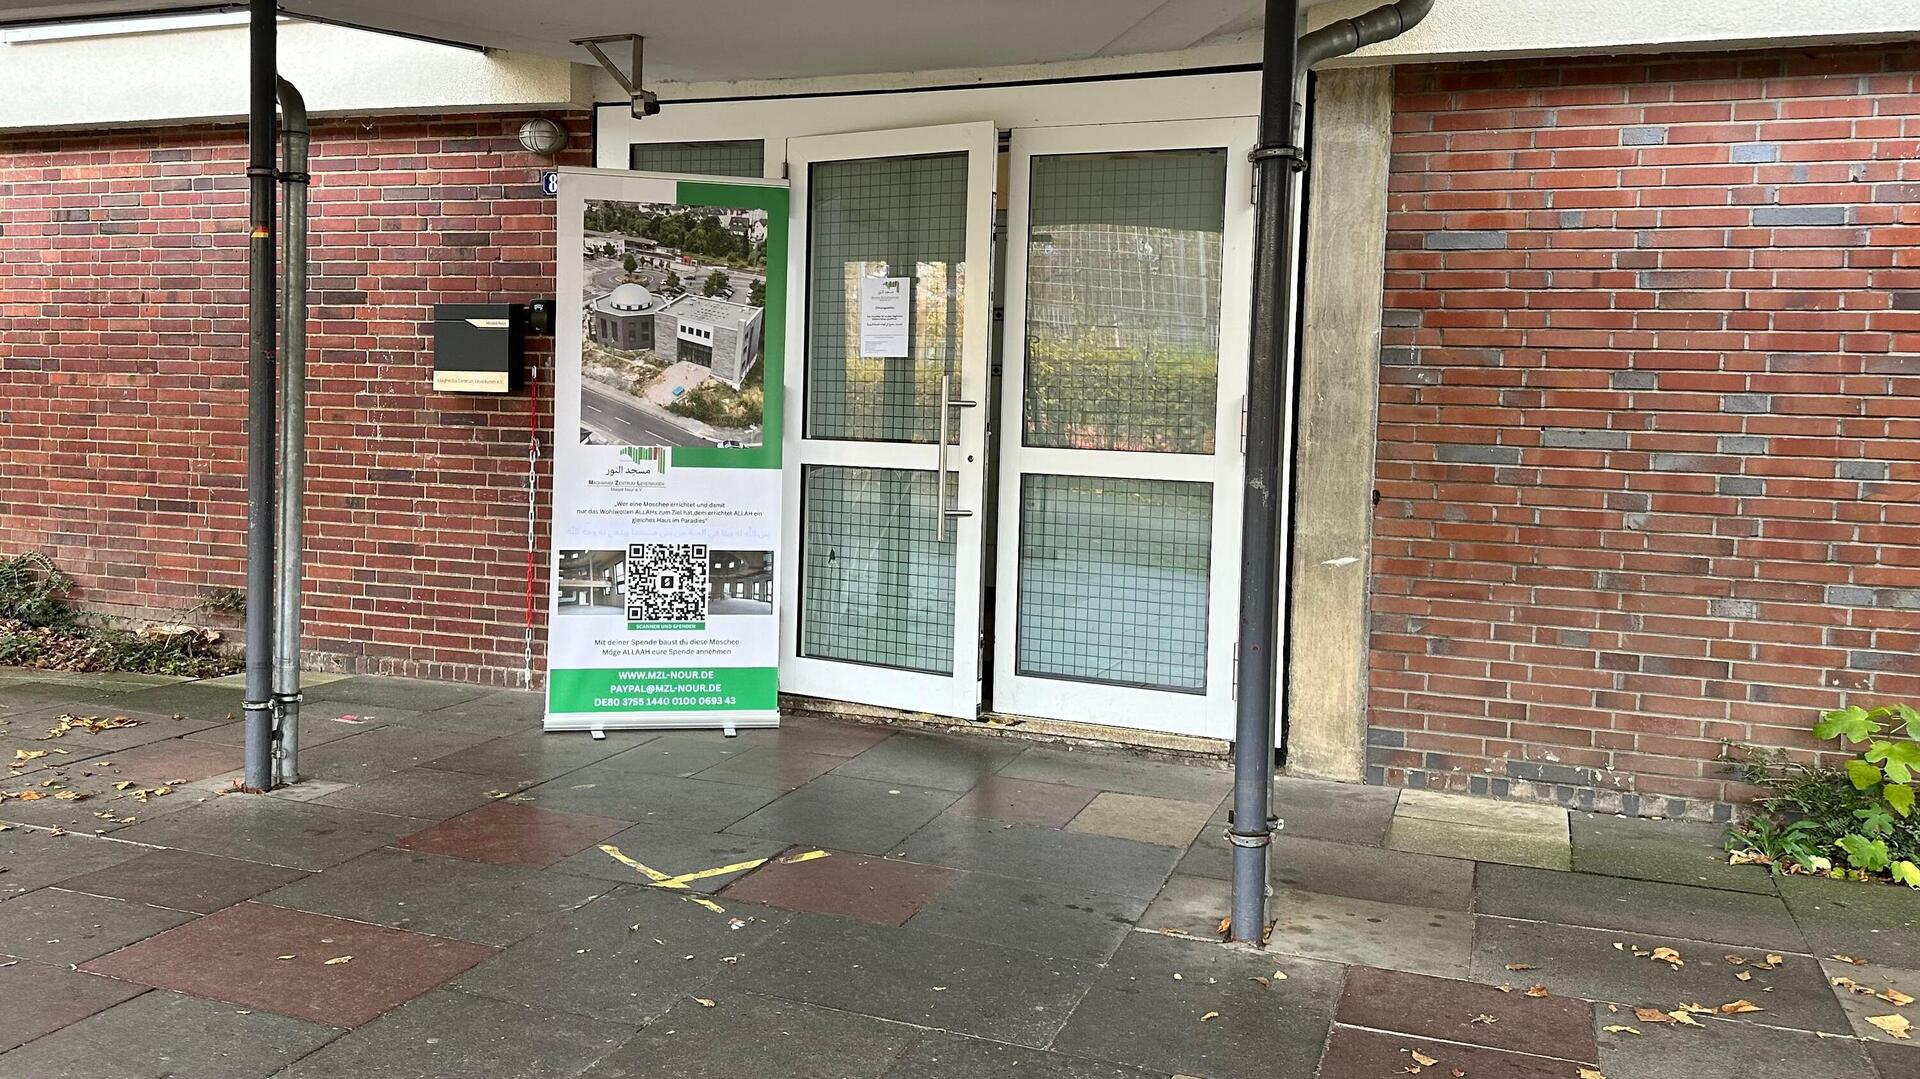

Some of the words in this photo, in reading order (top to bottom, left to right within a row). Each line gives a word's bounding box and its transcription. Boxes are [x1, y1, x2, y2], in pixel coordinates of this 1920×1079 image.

[549, 174, 558, 192] 8
[606, 466, 624, 476] النور
[625, 466, 650, 476] مسجد
[618, 671, 714, 680] WWW.MZL-NOUR.DE
[610, 684, 721, 694] PAYPAL@MZL-NOUR.DE
[594, 698, 620, 706] DE80
